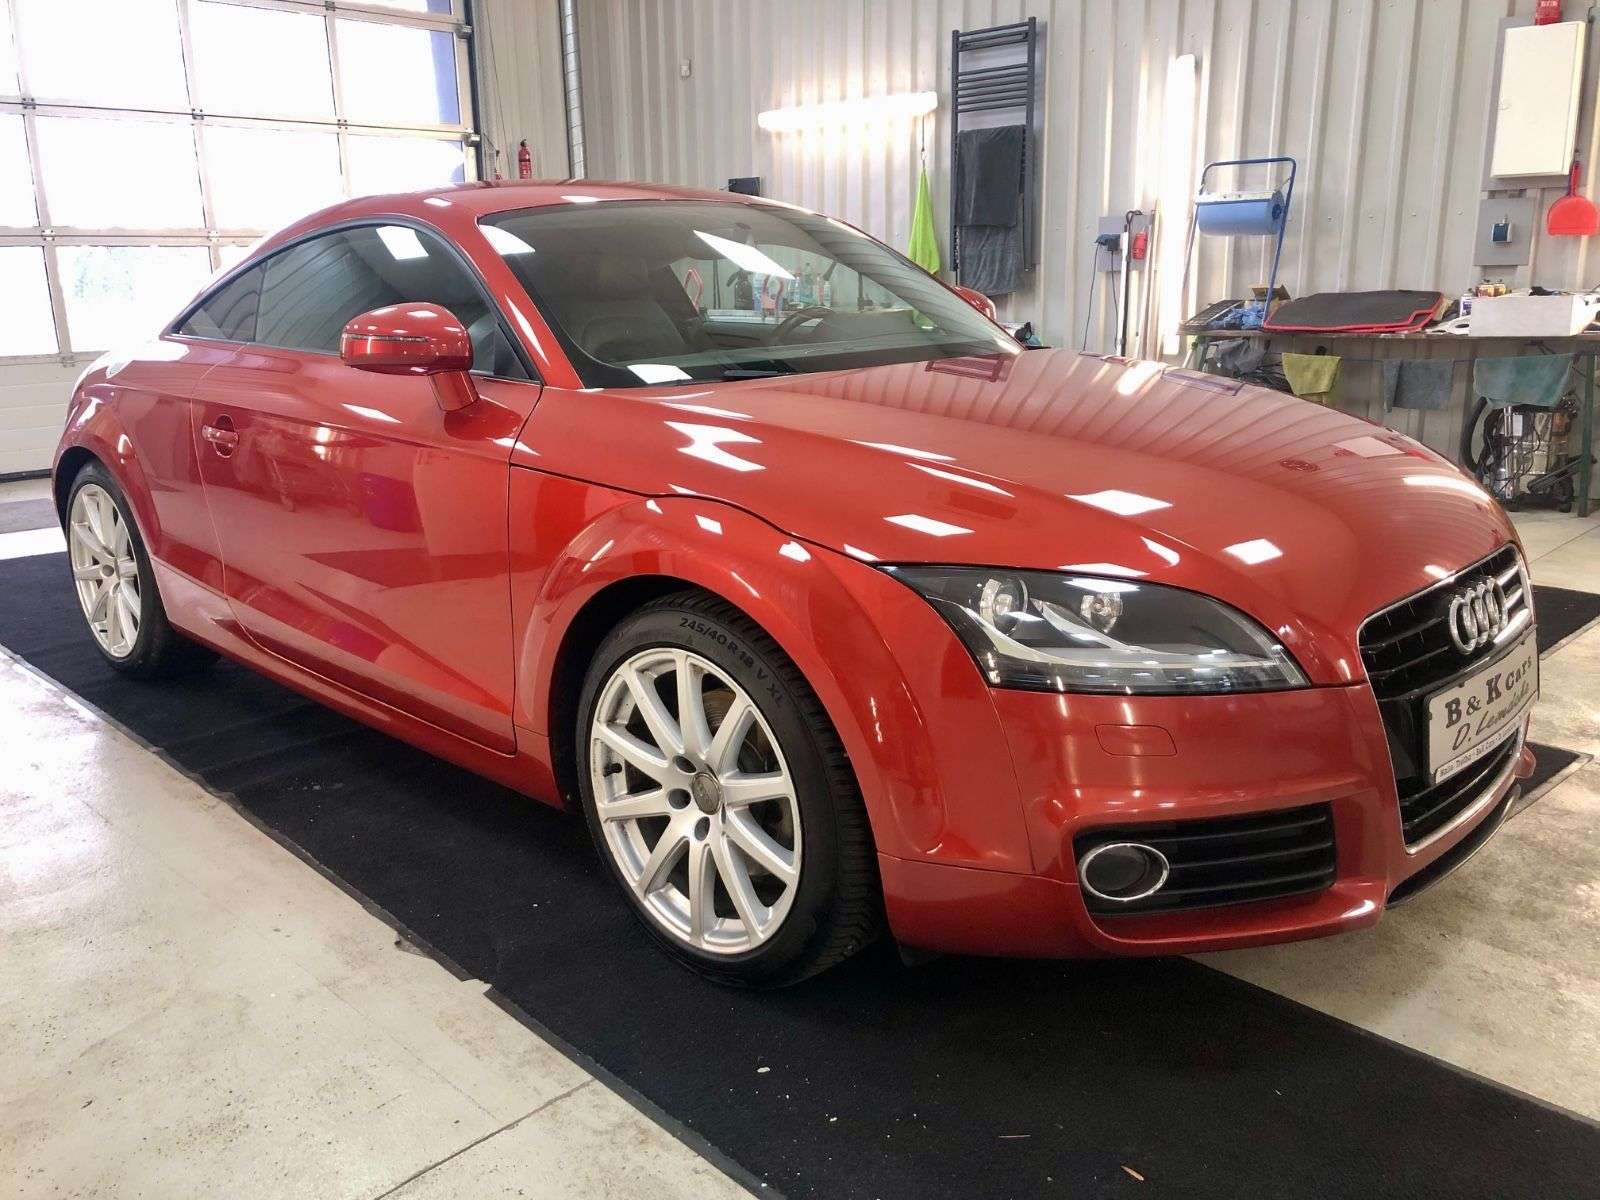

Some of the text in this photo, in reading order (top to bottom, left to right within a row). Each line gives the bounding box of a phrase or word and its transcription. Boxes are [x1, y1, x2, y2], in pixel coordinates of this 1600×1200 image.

[679, 617, 727, 645] 245/40
[1445, 697, 1462, 728] B
[1466, 695, 1481, 716] &
[1486, 672, 1501, 705] K
[1505, 655, 1533, 691] Cars
